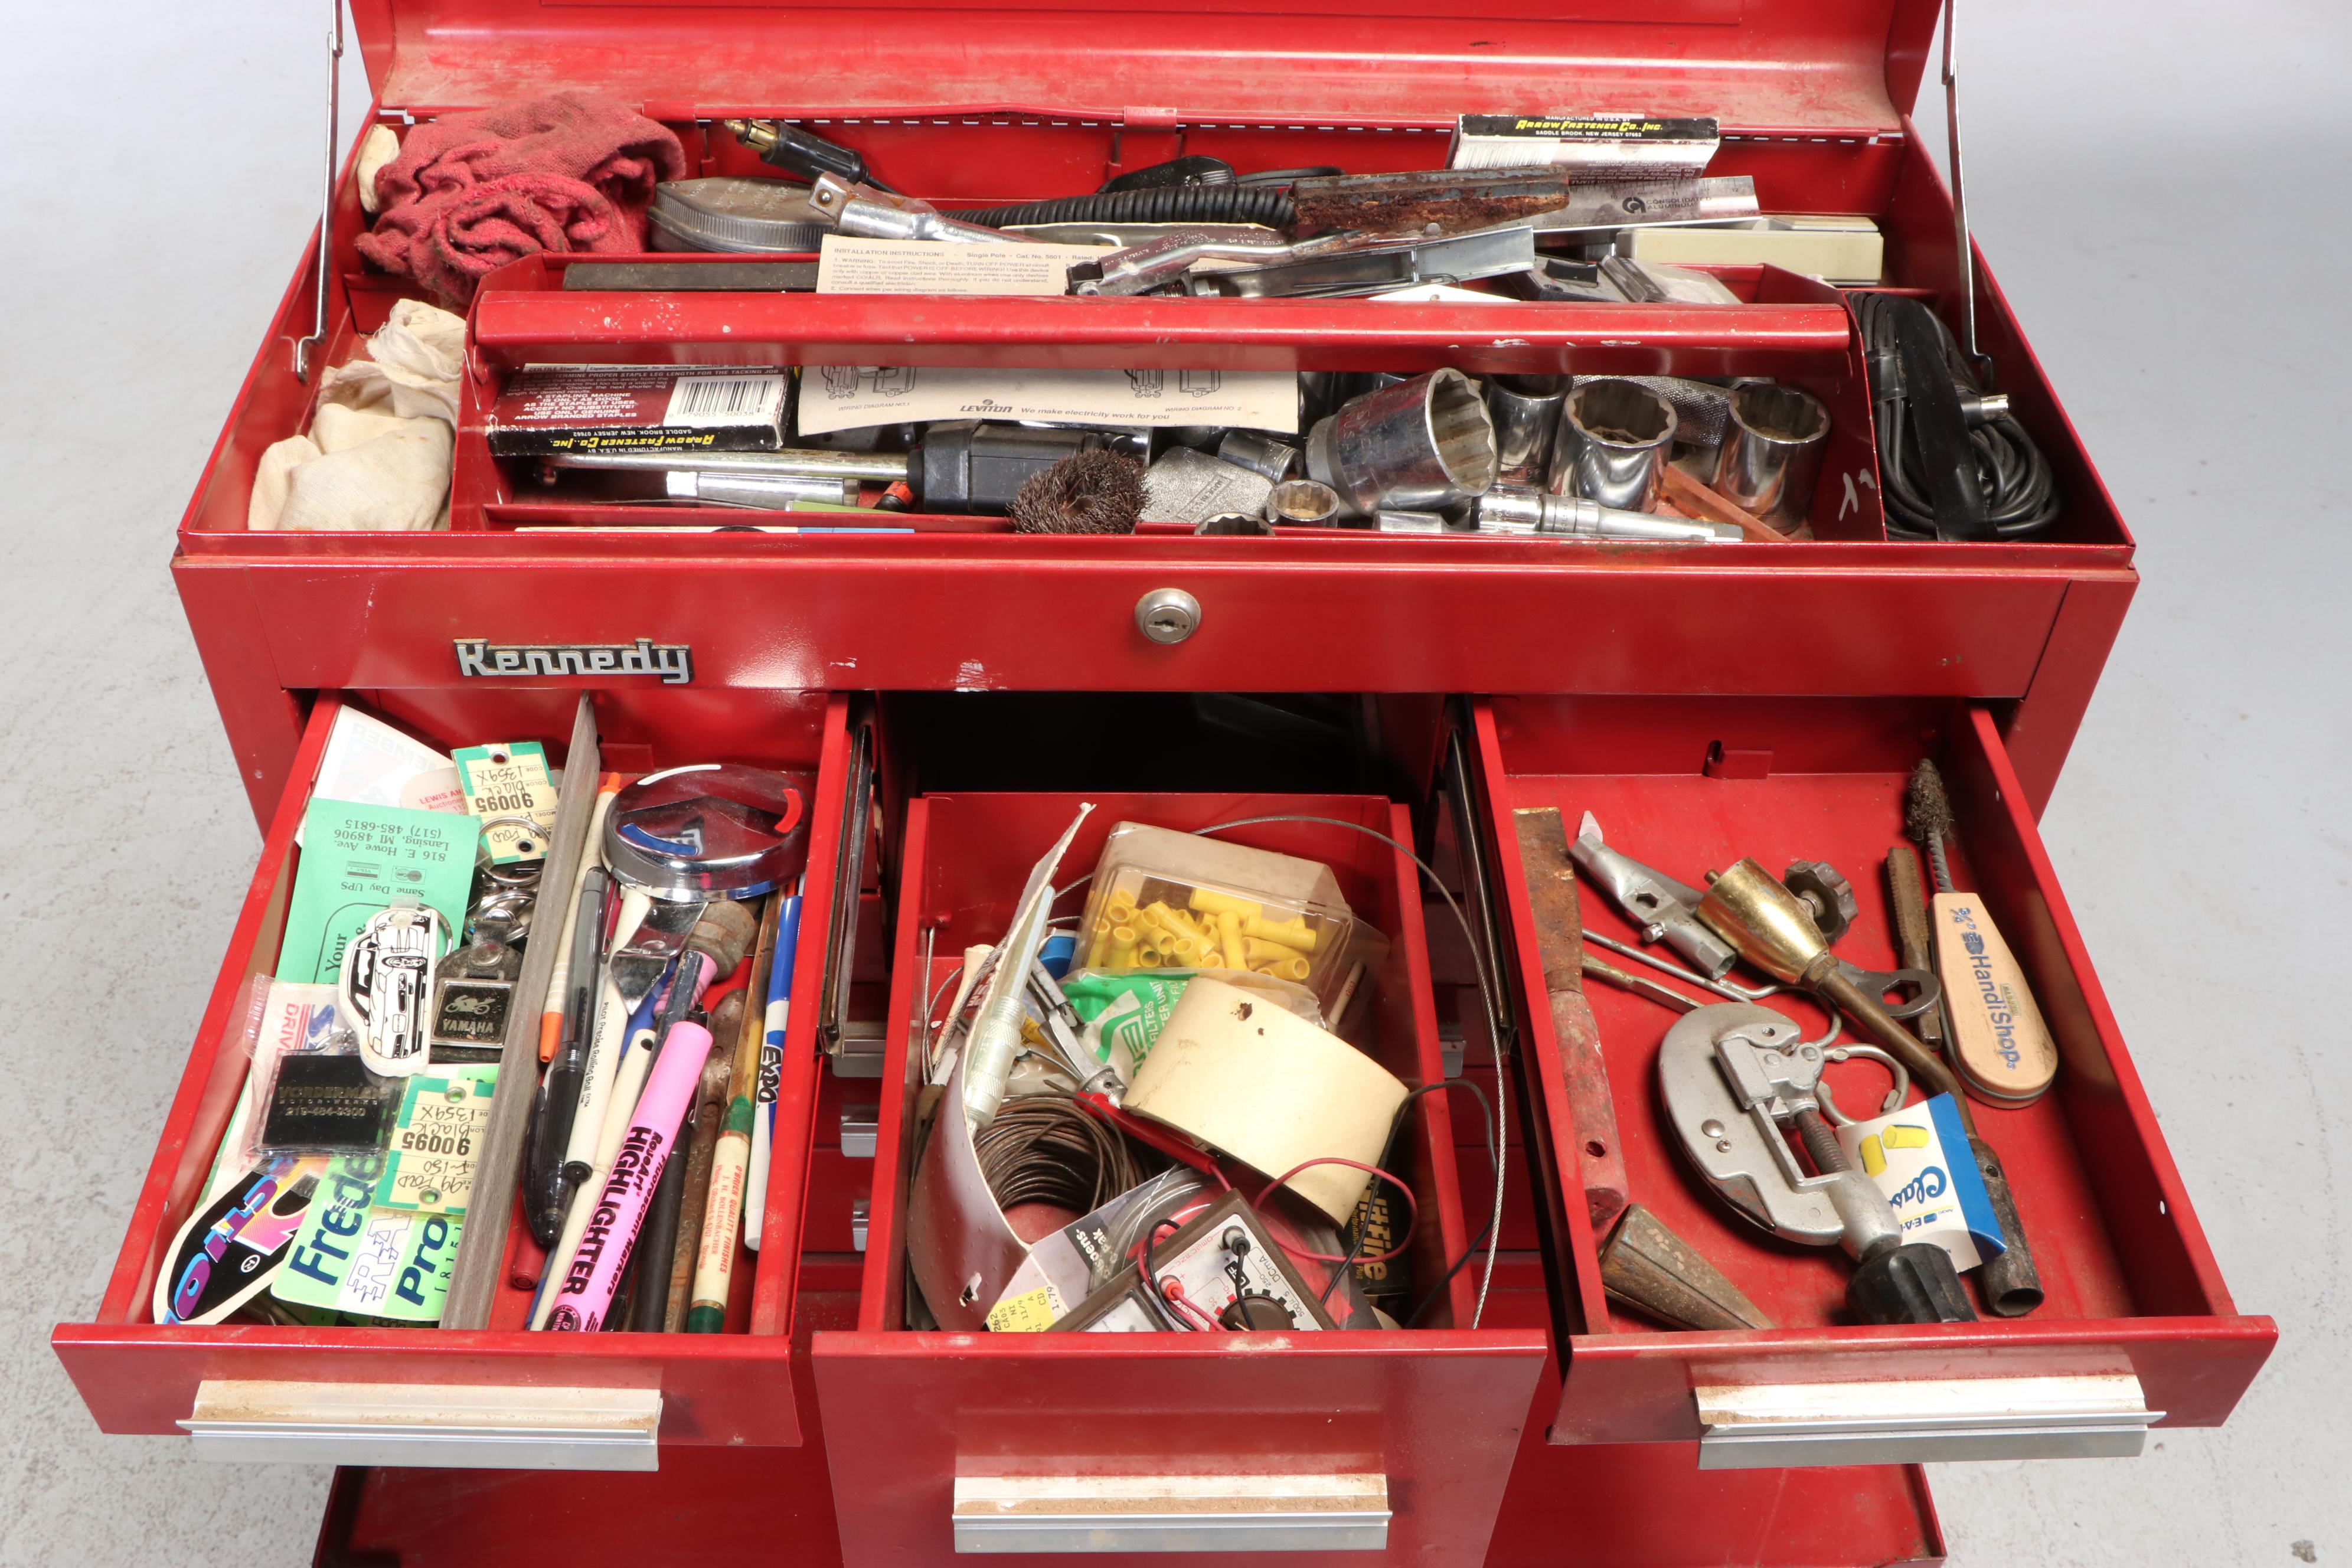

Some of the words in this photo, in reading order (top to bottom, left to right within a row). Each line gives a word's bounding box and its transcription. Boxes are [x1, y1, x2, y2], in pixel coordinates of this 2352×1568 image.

[1515, 120, 1560, 130] ARROW
[1560, 120, 1619, 130] FASTENER
[1646, 197, 1711, 205] CONSOLIDATED
[960, 403, 1013, 413] LEVITON
[1065, 409, 1109, 418] electricity
[600, 436, 665, 446] FASTENER
[665, 435, 715, 445] ARROW
[456, 641, 690, 684] Kennedy
[420, 792, 447, 804] LEWIS
[475, 793, 534, 812] 90095
[345, 819, 404, 834] 485-6815
[410, 825, 442, 838] (517)
[334, 829, 373, 842] 48906
[380, 835, 394, 845] MI
[403, 835, 449, 851] Lansing,
[334, 840, 359, 851] Ave.
[365, 844, 397, 856] Howe
[405, 849, 416, 858] E.
[423, 851, 446, 861] 816
[341, 881, 363, 891] UPS
[370, 883, 390, 894] Day
[397, 887, 426, 897] Same
[325, 933, 347, 972] Your
[443, 1018, 494, 1033] YAMAHA
[1144, 1001, 1159, 1042] FILTERS
[593, 1022, 606, 1048] Precise
[586, 1050, 599, 1075] Rolling
[584, 1076, 594, 1091] Ball
[401, 1132, 471, 1156] 90095
[731, 1165, 743, 1197] O'BRIEN
[632, 1154, 666, 1236] Fluorescent
[561, 1126, 652, 1295] HIGHLIGHTER
[726, 1198, 737, 1234] QUALITY
[711, 1197, 726, 1255] BOLLENBACHER
[395, 1214, 448, 1306] Pro
[720, 1236, 732, 1274] FINISHES
[607, 1237, 633, 1296] Markers
[1259, 1256, 1281, 1283] DCmA
[1259, 1274, 1272, 1288] 250
[1223, 1285, 1231, 1295] 10
[1037, 1293, 1046, 1305] CD
[1047, 1286, 1059, 1310] 1.79
